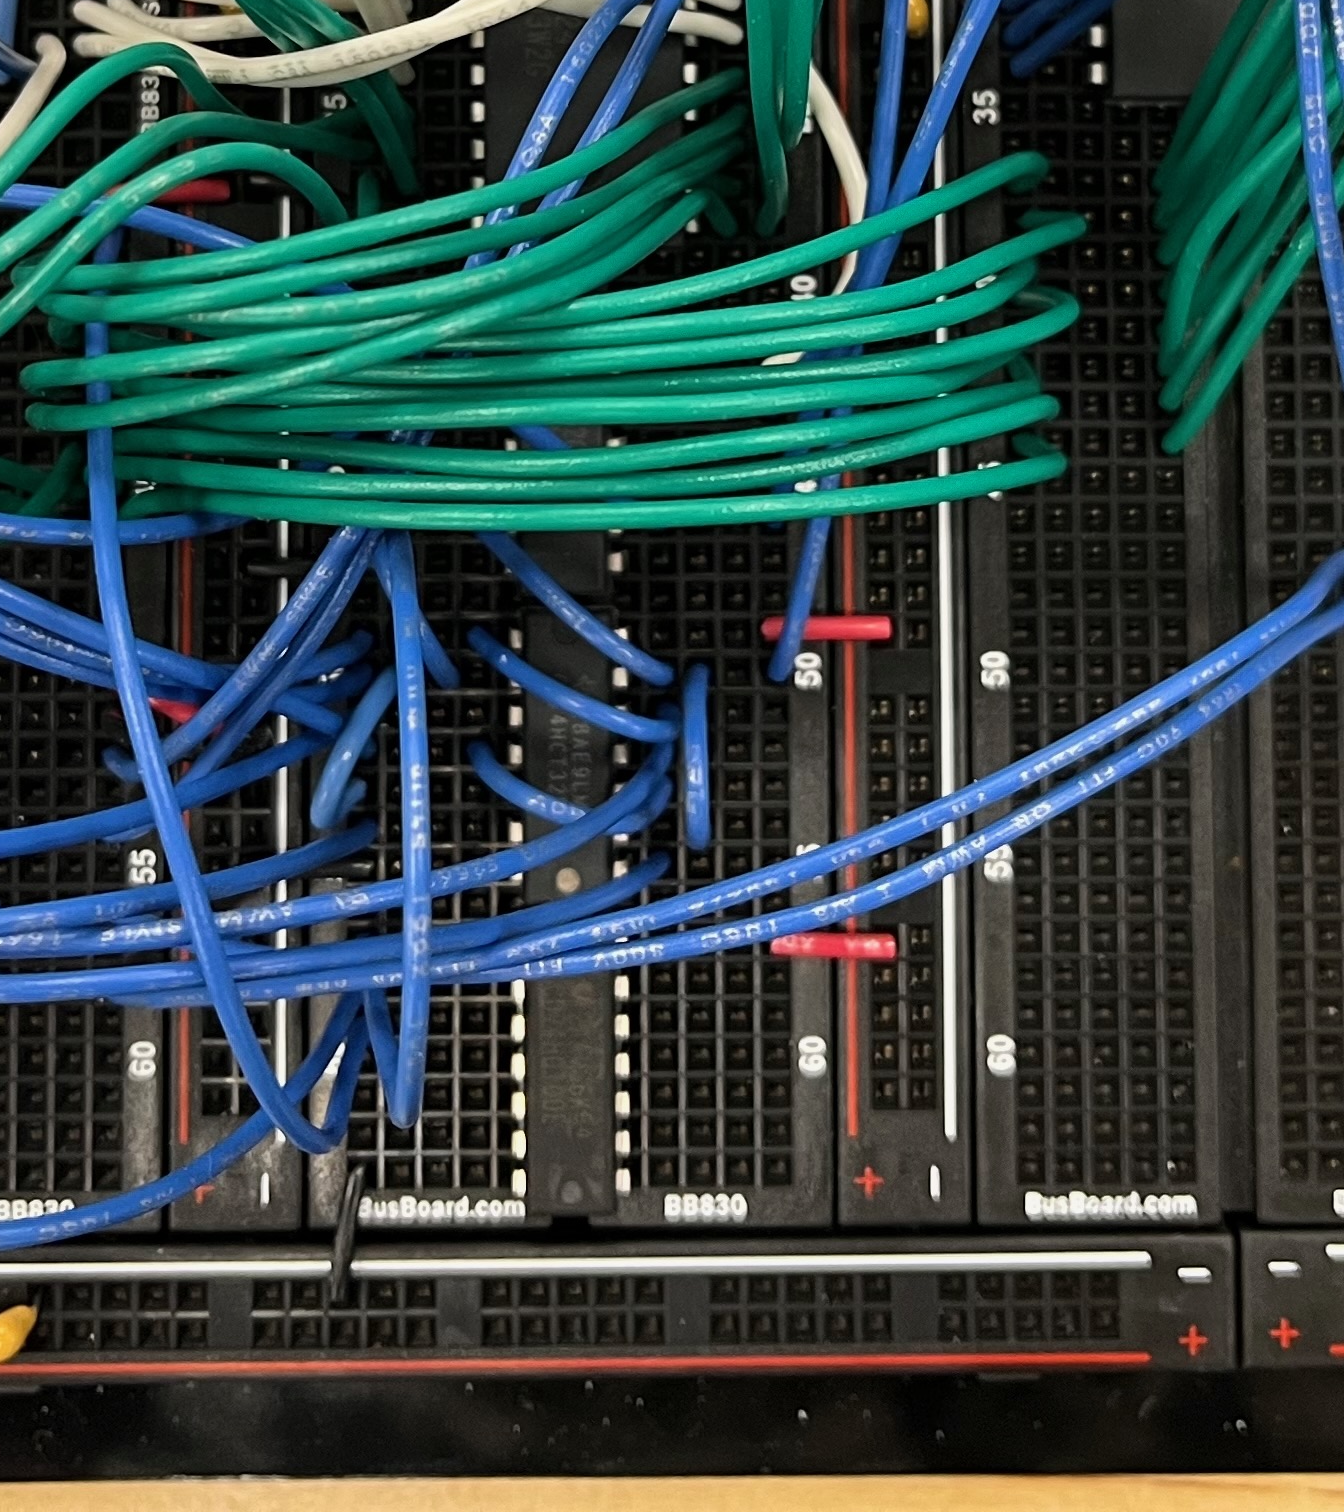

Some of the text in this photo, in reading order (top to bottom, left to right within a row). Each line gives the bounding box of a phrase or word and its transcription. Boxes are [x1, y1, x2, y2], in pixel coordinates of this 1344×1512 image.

[971, 90, 1001, 126] 35
[793, 651, 824, 689] 50
[980, 651, 1012, 689] 50
[128, 848, 157, 885] 55
[983, 844, 1015, 882] 55
[127, 1040, 157, 1079] 60
[798, 1034, 828, 1078] 60
[986, 1033, 1017, 1078] 60
[663, 1192, 749, 1221] BB830
[1024, 1191, 1199, 1223] BusBoard.com
